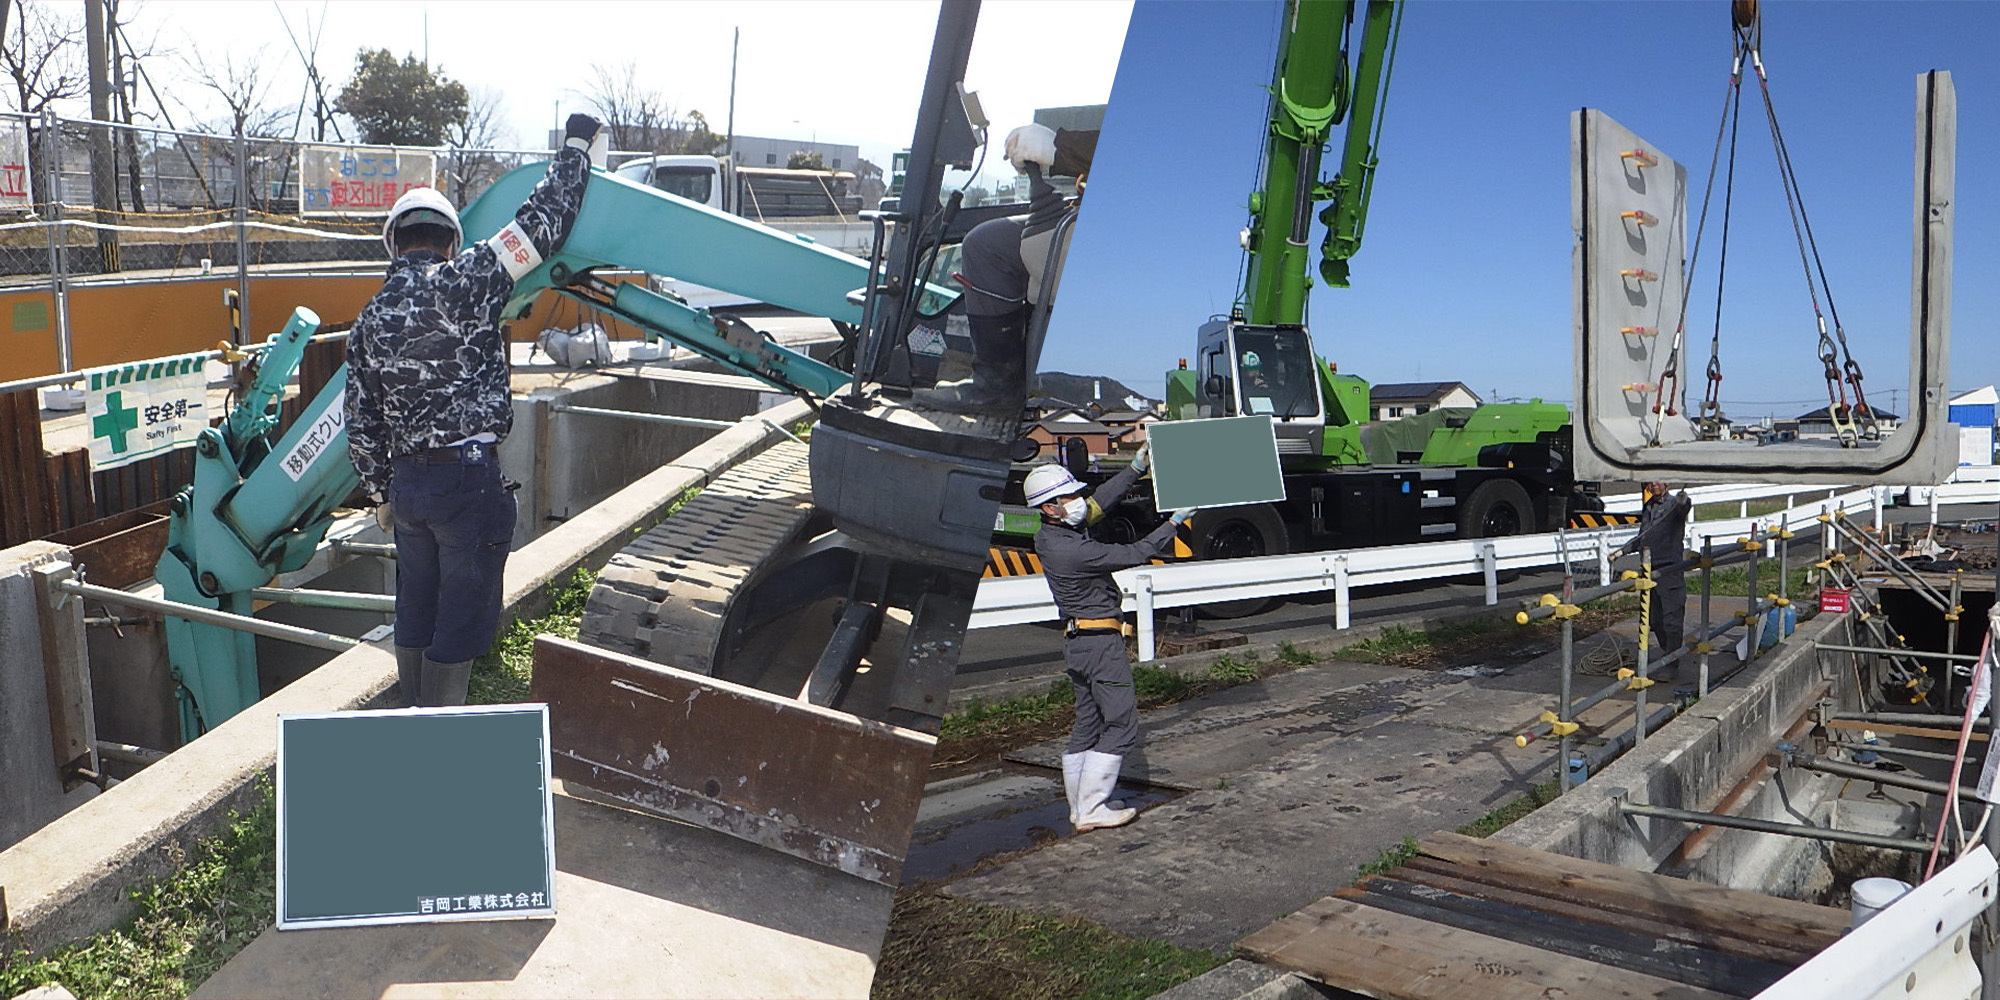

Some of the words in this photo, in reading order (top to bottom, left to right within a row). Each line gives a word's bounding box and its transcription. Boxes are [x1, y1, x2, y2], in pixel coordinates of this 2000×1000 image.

[144, 398, 202, 426] 安全第一
[286, 412, 342, 475] 移動式クレ
[420, 892, 545, 913] 吉岡工業株式会社
